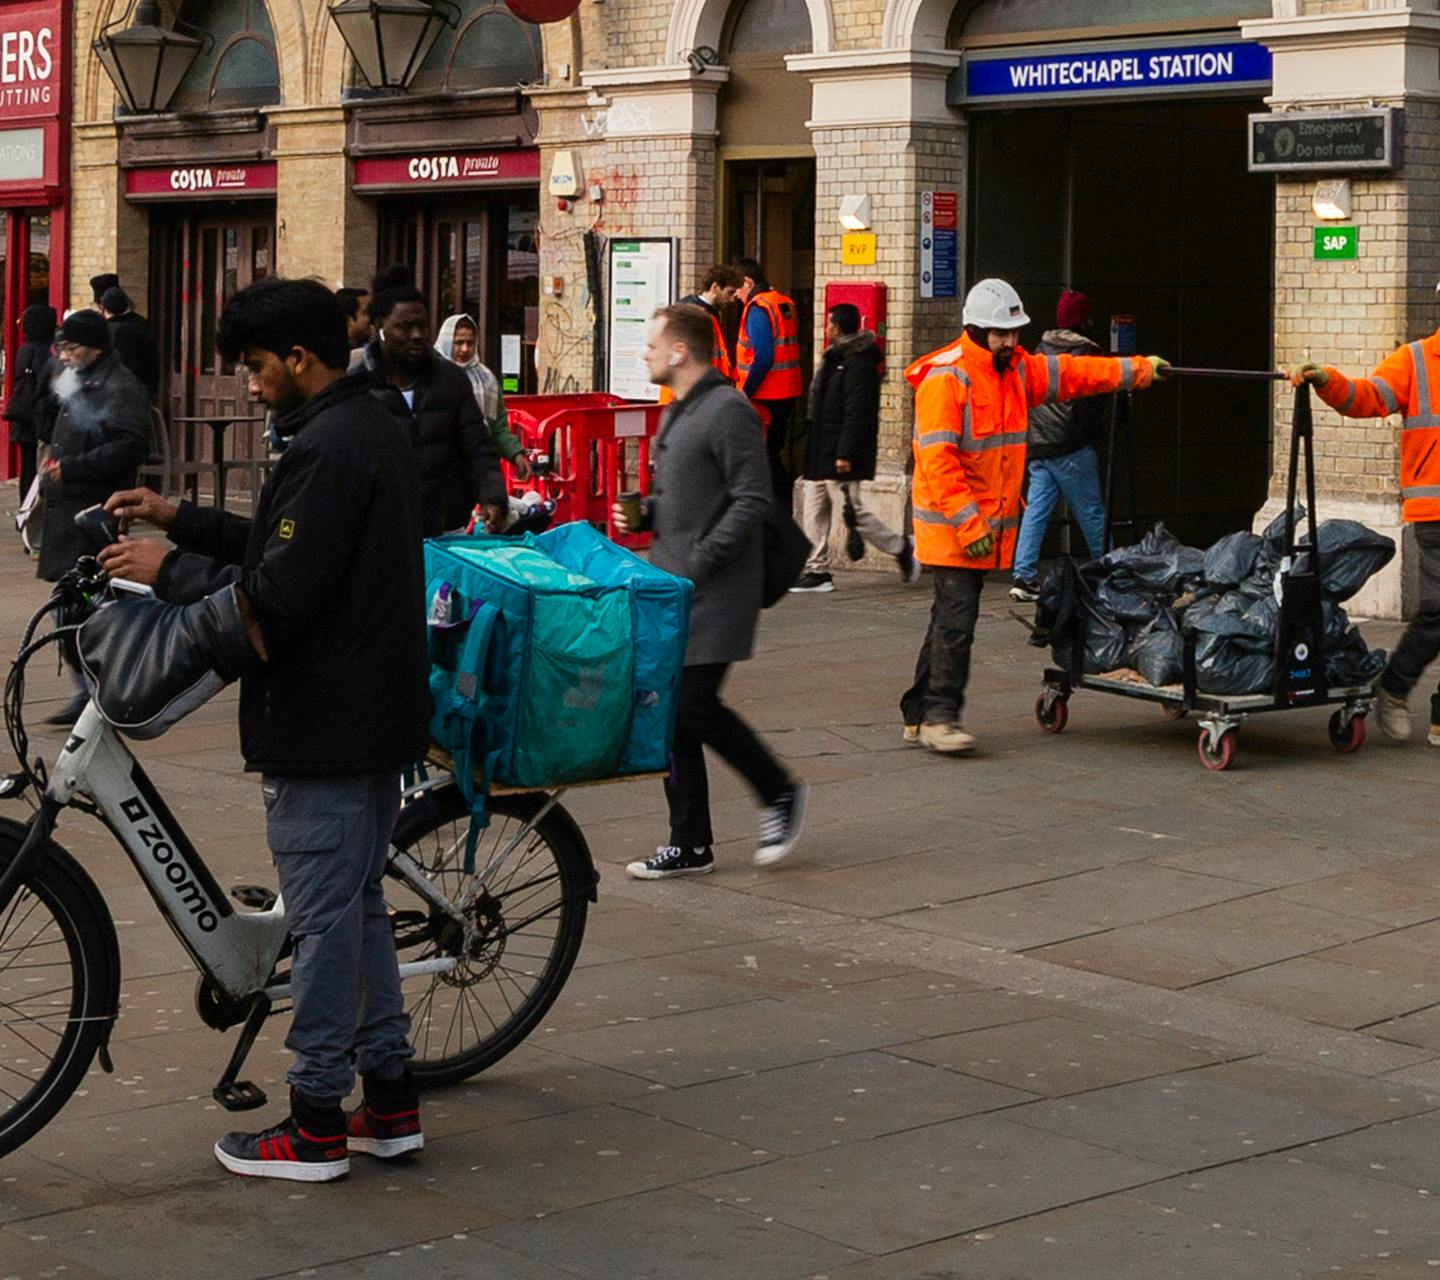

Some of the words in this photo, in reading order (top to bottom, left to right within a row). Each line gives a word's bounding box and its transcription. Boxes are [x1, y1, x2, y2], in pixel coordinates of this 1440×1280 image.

[1010, 57, 1144, 88] WHITECHAPEL
[1148, 52, 1233, 79] STATION
[1299, 121, 1362, 138] Emergency
[1297, 144, 1312, 158] Do
[1315, 143, 1333, 157] not
[1335, 141, 1365, 156] enter
[408, 155, 459, 181] COSTA
[463, 155, 500, 175] pronto
[170, 169, 213, 191] COSTA
[216, 168, 246, 186] pronto
[849, 244, 867, 254] RVP
[1323, 236, 1348, 252] SAP
[136, 822, 219, 934] zoomo
